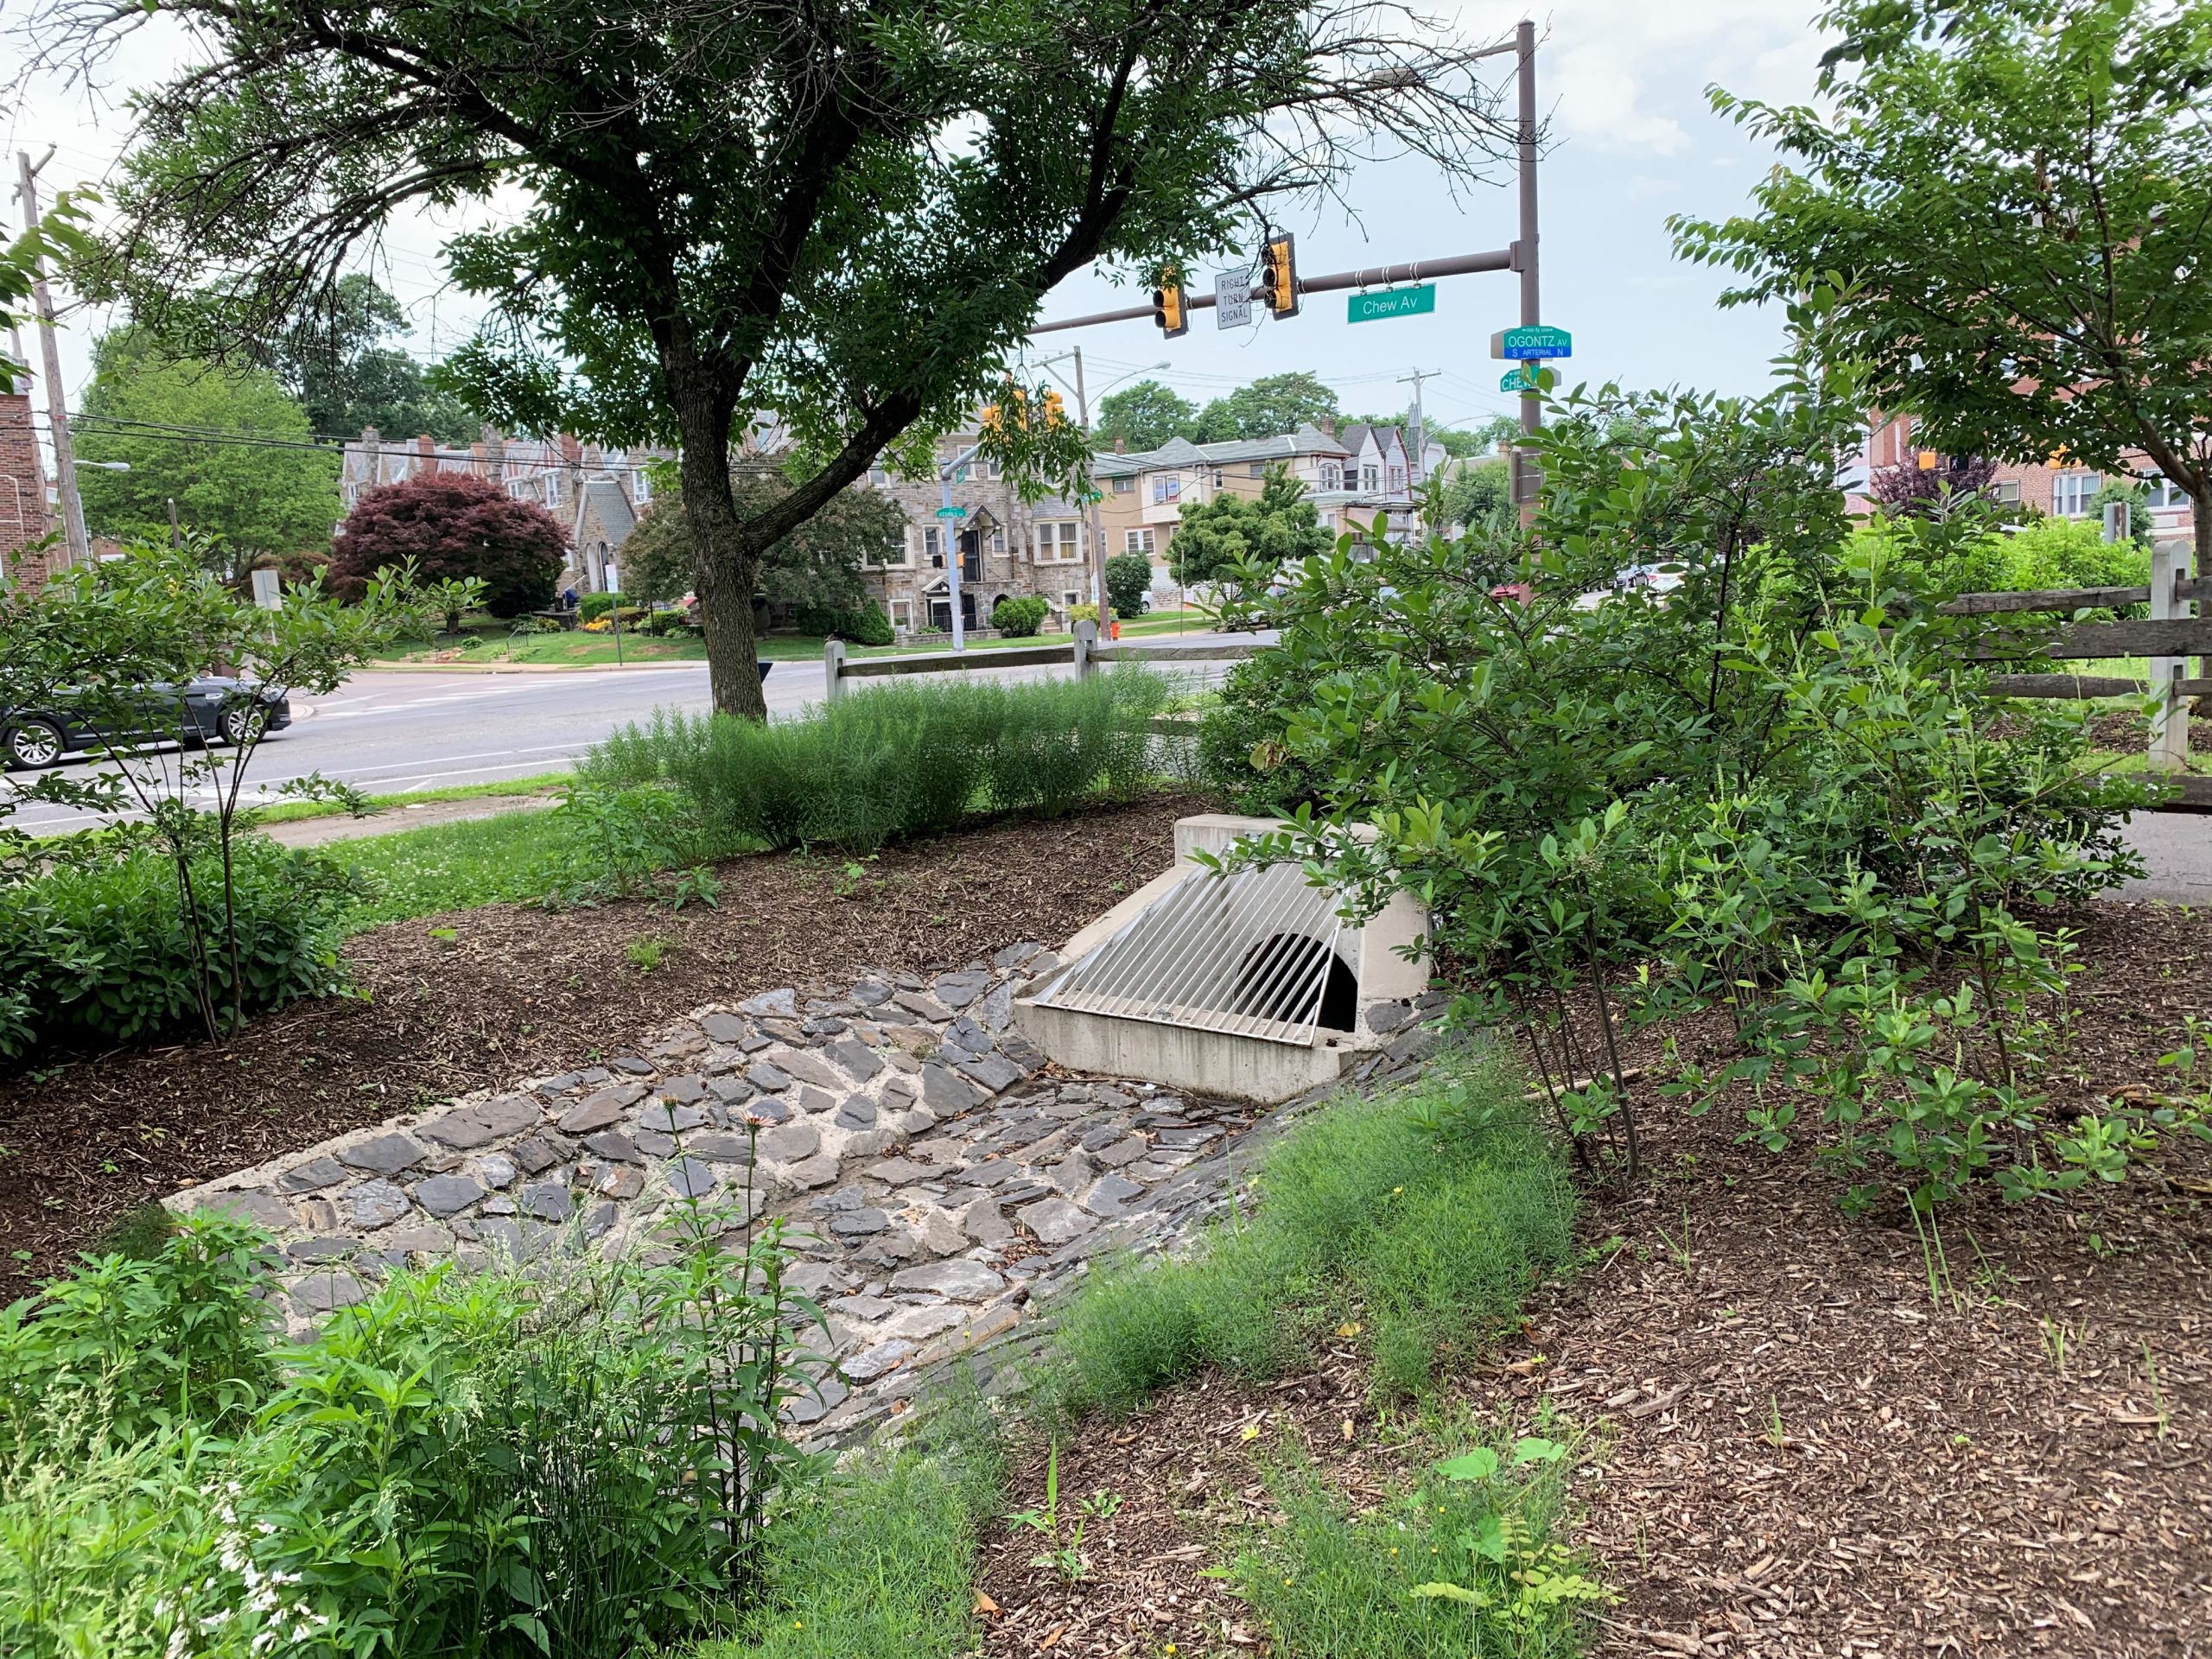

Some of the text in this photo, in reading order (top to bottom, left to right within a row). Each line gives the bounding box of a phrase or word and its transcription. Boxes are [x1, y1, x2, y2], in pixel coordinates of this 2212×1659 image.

[1221, 276, 1244, 291] RIGHT
[1224, 292, 1243, 306] TURN
[1363, 296, 1417, 315] Chew Av
[1221, 307, 1248, 322] SIGNAL
[1508, 335, 1554, 347] OGONTZ
[1512, 348, 1518, 357] S
[1557, 348, 1564, 357] N
